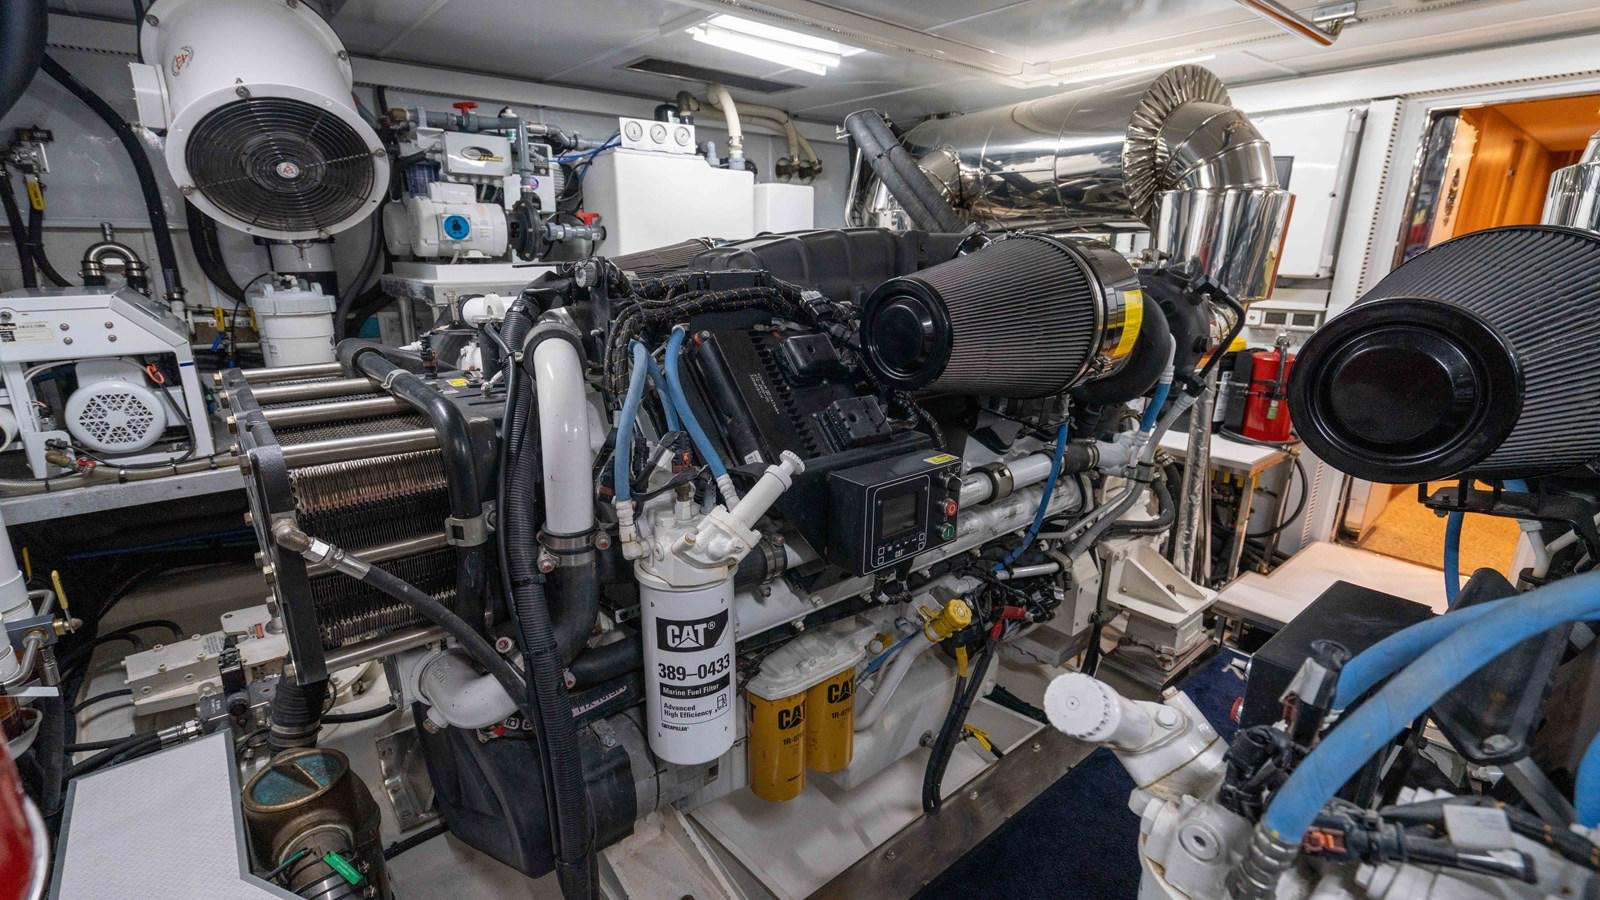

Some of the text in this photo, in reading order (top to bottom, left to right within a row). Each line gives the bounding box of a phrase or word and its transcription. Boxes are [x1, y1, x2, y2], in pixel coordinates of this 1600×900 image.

[662, 684, 719, 696] Marine Fuel Filter
[663, 702, 696, 711] Advanced
[663, 709, 713, 718] High Efficiency
